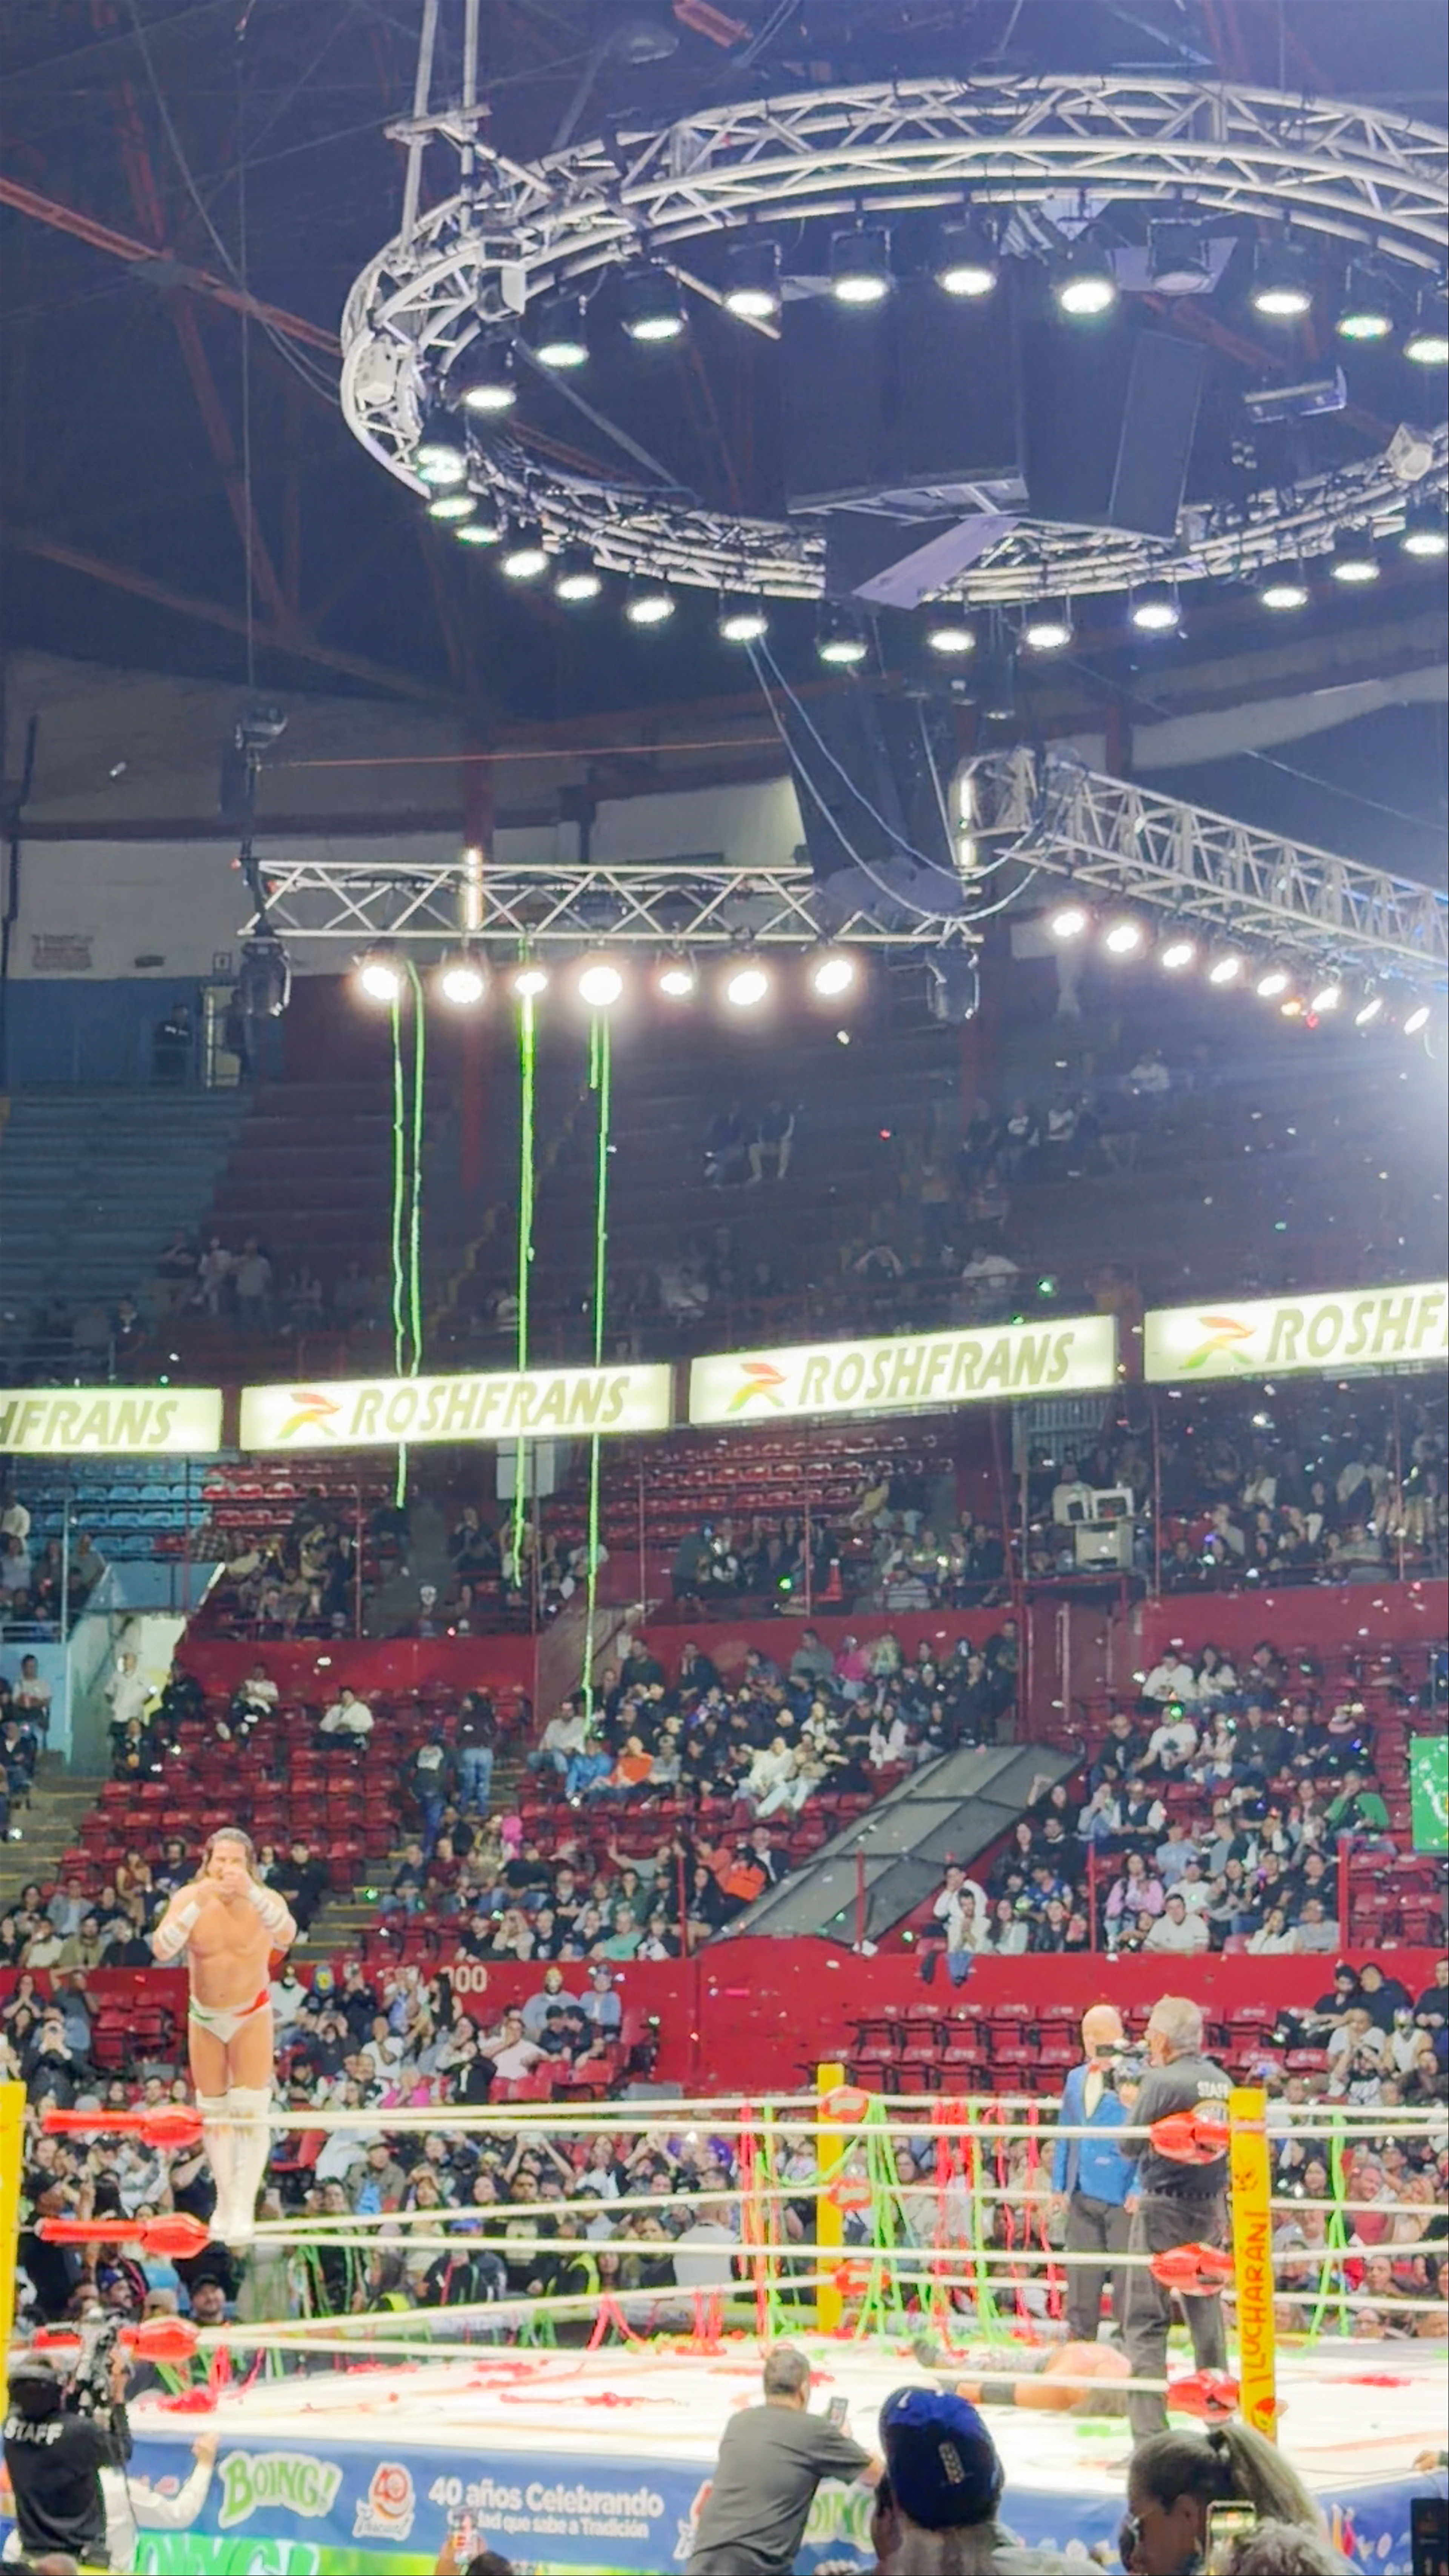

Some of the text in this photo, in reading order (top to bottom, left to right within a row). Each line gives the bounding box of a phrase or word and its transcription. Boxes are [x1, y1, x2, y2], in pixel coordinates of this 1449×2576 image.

[1264, 1294, 1448, 1363] ROSHF
[798, 1332, 1075, 1405] ROSHFRANS
[349, 1376, 629, 1435] ROSHFRANS
[4, 2416, 64, 2446] STAFF
[223, 2456, 336, 2518] BOING!
[429, 2477, 665, 2518] 40 años Celebrando
[503, 2515, 530, 2534] que
[533, 2516, 566, 2534] sabe
[568, 2520, 579, 2535] a
[580, 2517, 649, 2539] Tradición
